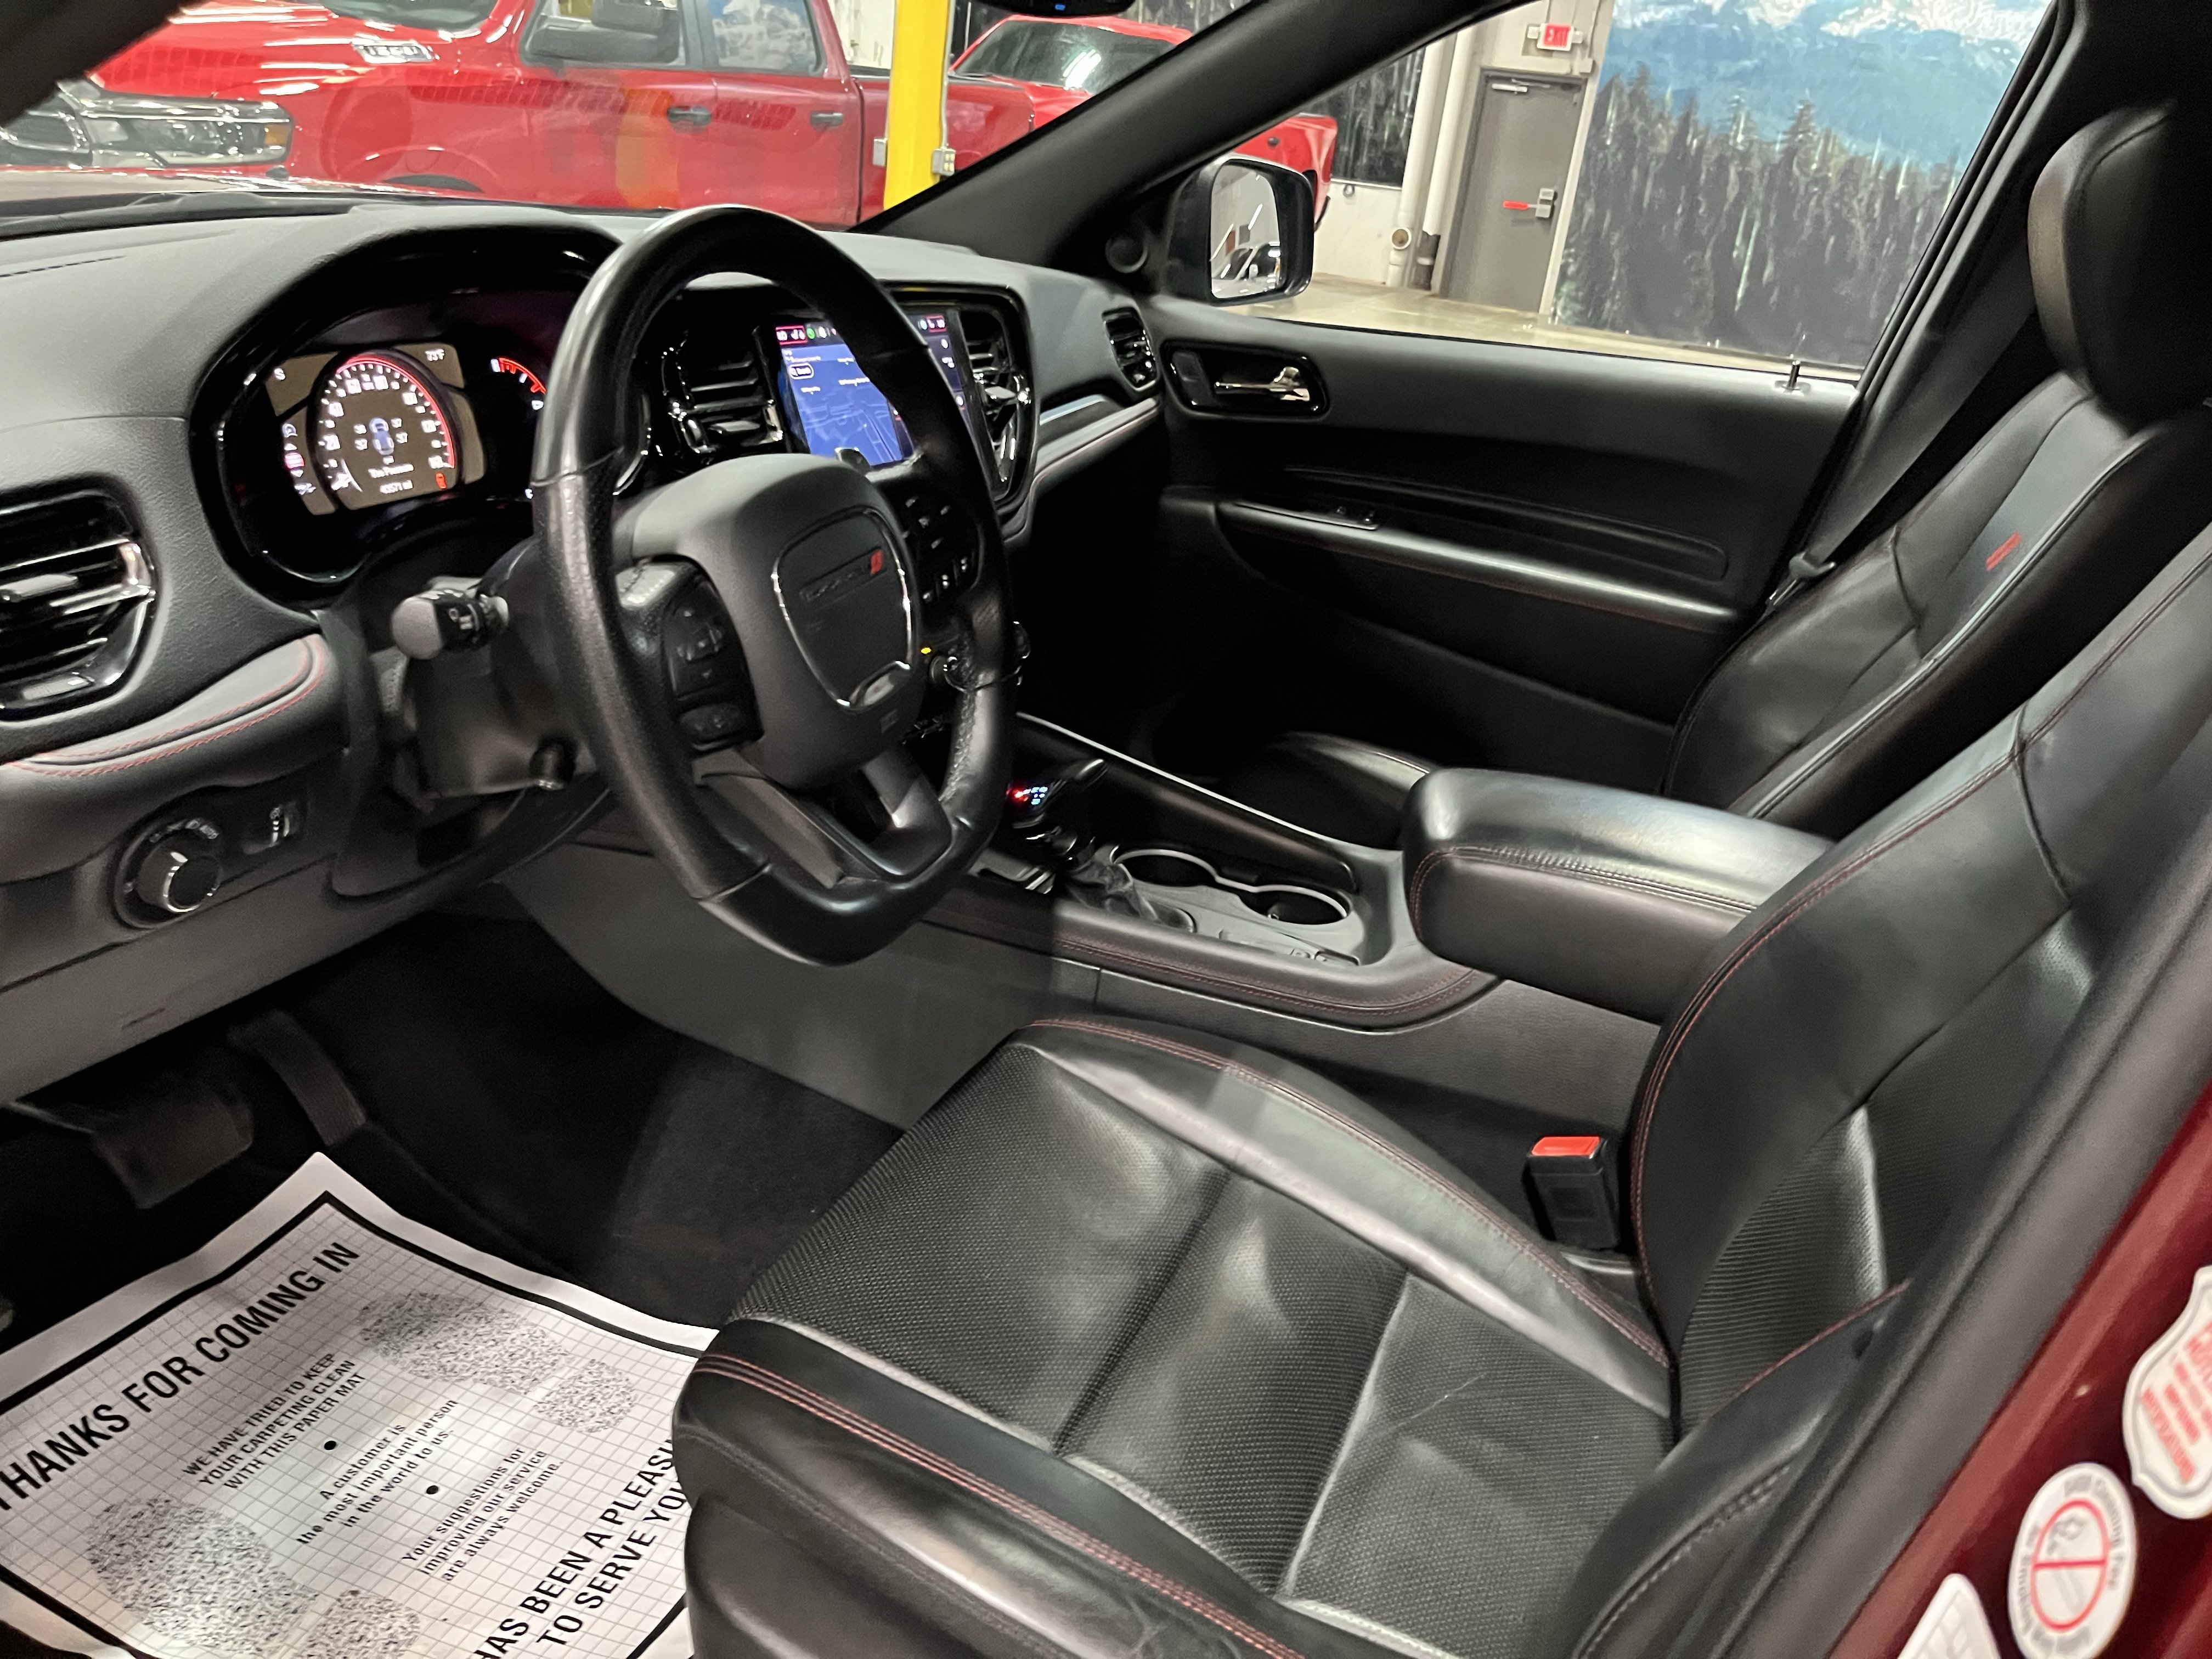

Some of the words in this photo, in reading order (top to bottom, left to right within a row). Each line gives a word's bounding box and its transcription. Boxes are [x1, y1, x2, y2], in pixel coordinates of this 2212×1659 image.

[122, 1357, 205, 1413] FOR
[195, 1271, 325, 1362] COMING
[313, 1242, 359, 1273] IN
[183, 1456, 212, 1476] WE
[207, 1427, 248, 1458] HAVE
[246, 1396, 286, 1427] TRIED
[284, 1381, 305, 1395] TO
[302, 1353, 335, 1381] KEEP
[199, 1454, 244, 1485] YOUR
[240, 1395, 314, 1454] CARPETING
[312, 1360, 356, 1395] CLEAN
[224, 1459, 265, 1489] WITH
[261, 1432, 296, 1458] THIS
[294, 1397, 339, 1432] PAPER
[335, 1374, 365, 1397] MAT
[296, 1525, 324, 1544] the
[323, 1492, 358, 1522] most
[354, 1436, 418, 1491] important
[415, 1399, 459, 1437] person
[320, 1490, 334, 1500] A
[333, 1437, 391, 1488] customer
[387, 1425, 405, 1435] is
[339, 1515, 360, 1527] in
[357, 1494, 382, 1513] the
[380, 1460, 419, 1492] world
[414, 1447, 433, 1459] to
[402, 1535, 437, 1561] Your
[436, 1466, 508, 1534] suggestions
[503, 1447, 526, 1464] for
[418, 1515, 487, 1575] improving
[482, 1493, 506, 1513] our
[503, 1450, 547, 1492] service
[442, 1559, 466, 1581] are
[465, 1515, 510, 1557] always
[506, 1462, 563, 1513] welcome.
[520, 1550, 593, 1614] BEEN
[583, 1531, 614, 1548] A
[535, 1614, 583, 1645] TO
[575, 1530, 658, 1609] SERVE
